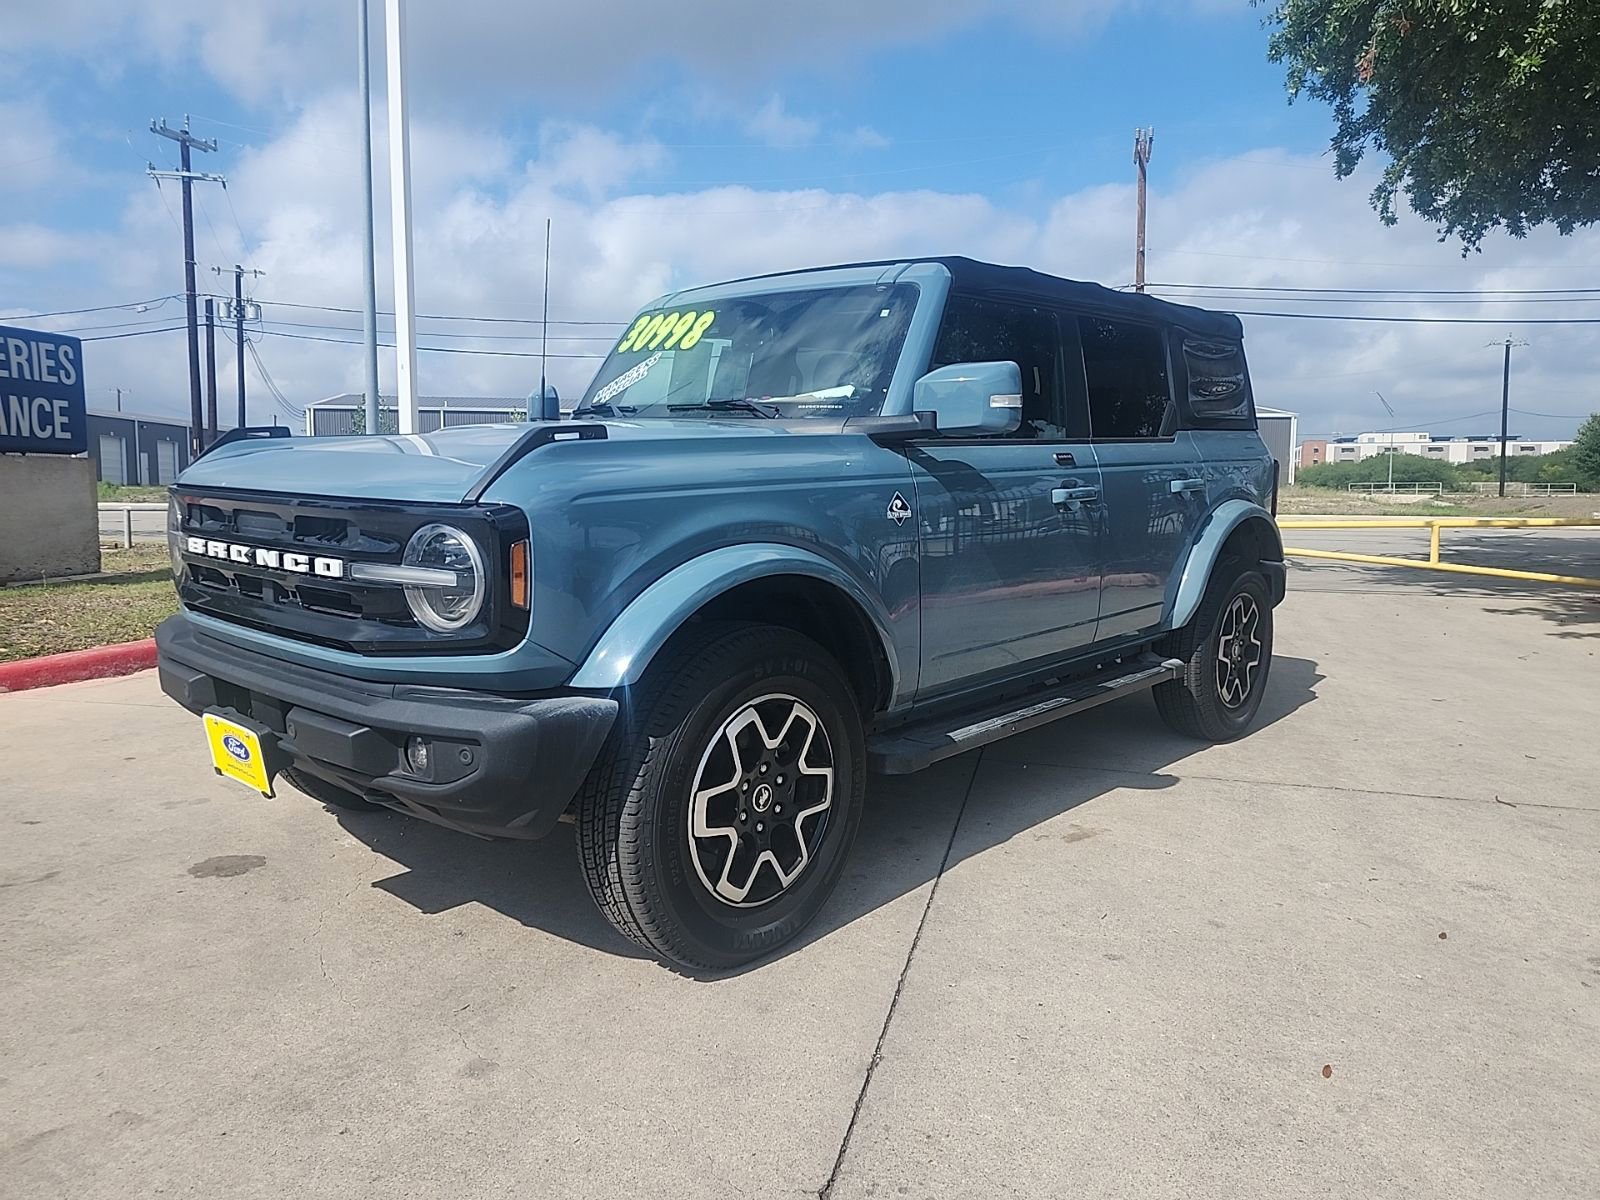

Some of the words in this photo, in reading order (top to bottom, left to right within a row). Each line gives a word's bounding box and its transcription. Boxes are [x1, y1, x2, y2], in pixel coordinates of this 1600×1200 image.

[617, 310, 715, 353] 30998
[188, 536, 344, 578] BRONCO
[227, 737, 247, 759] Ford
